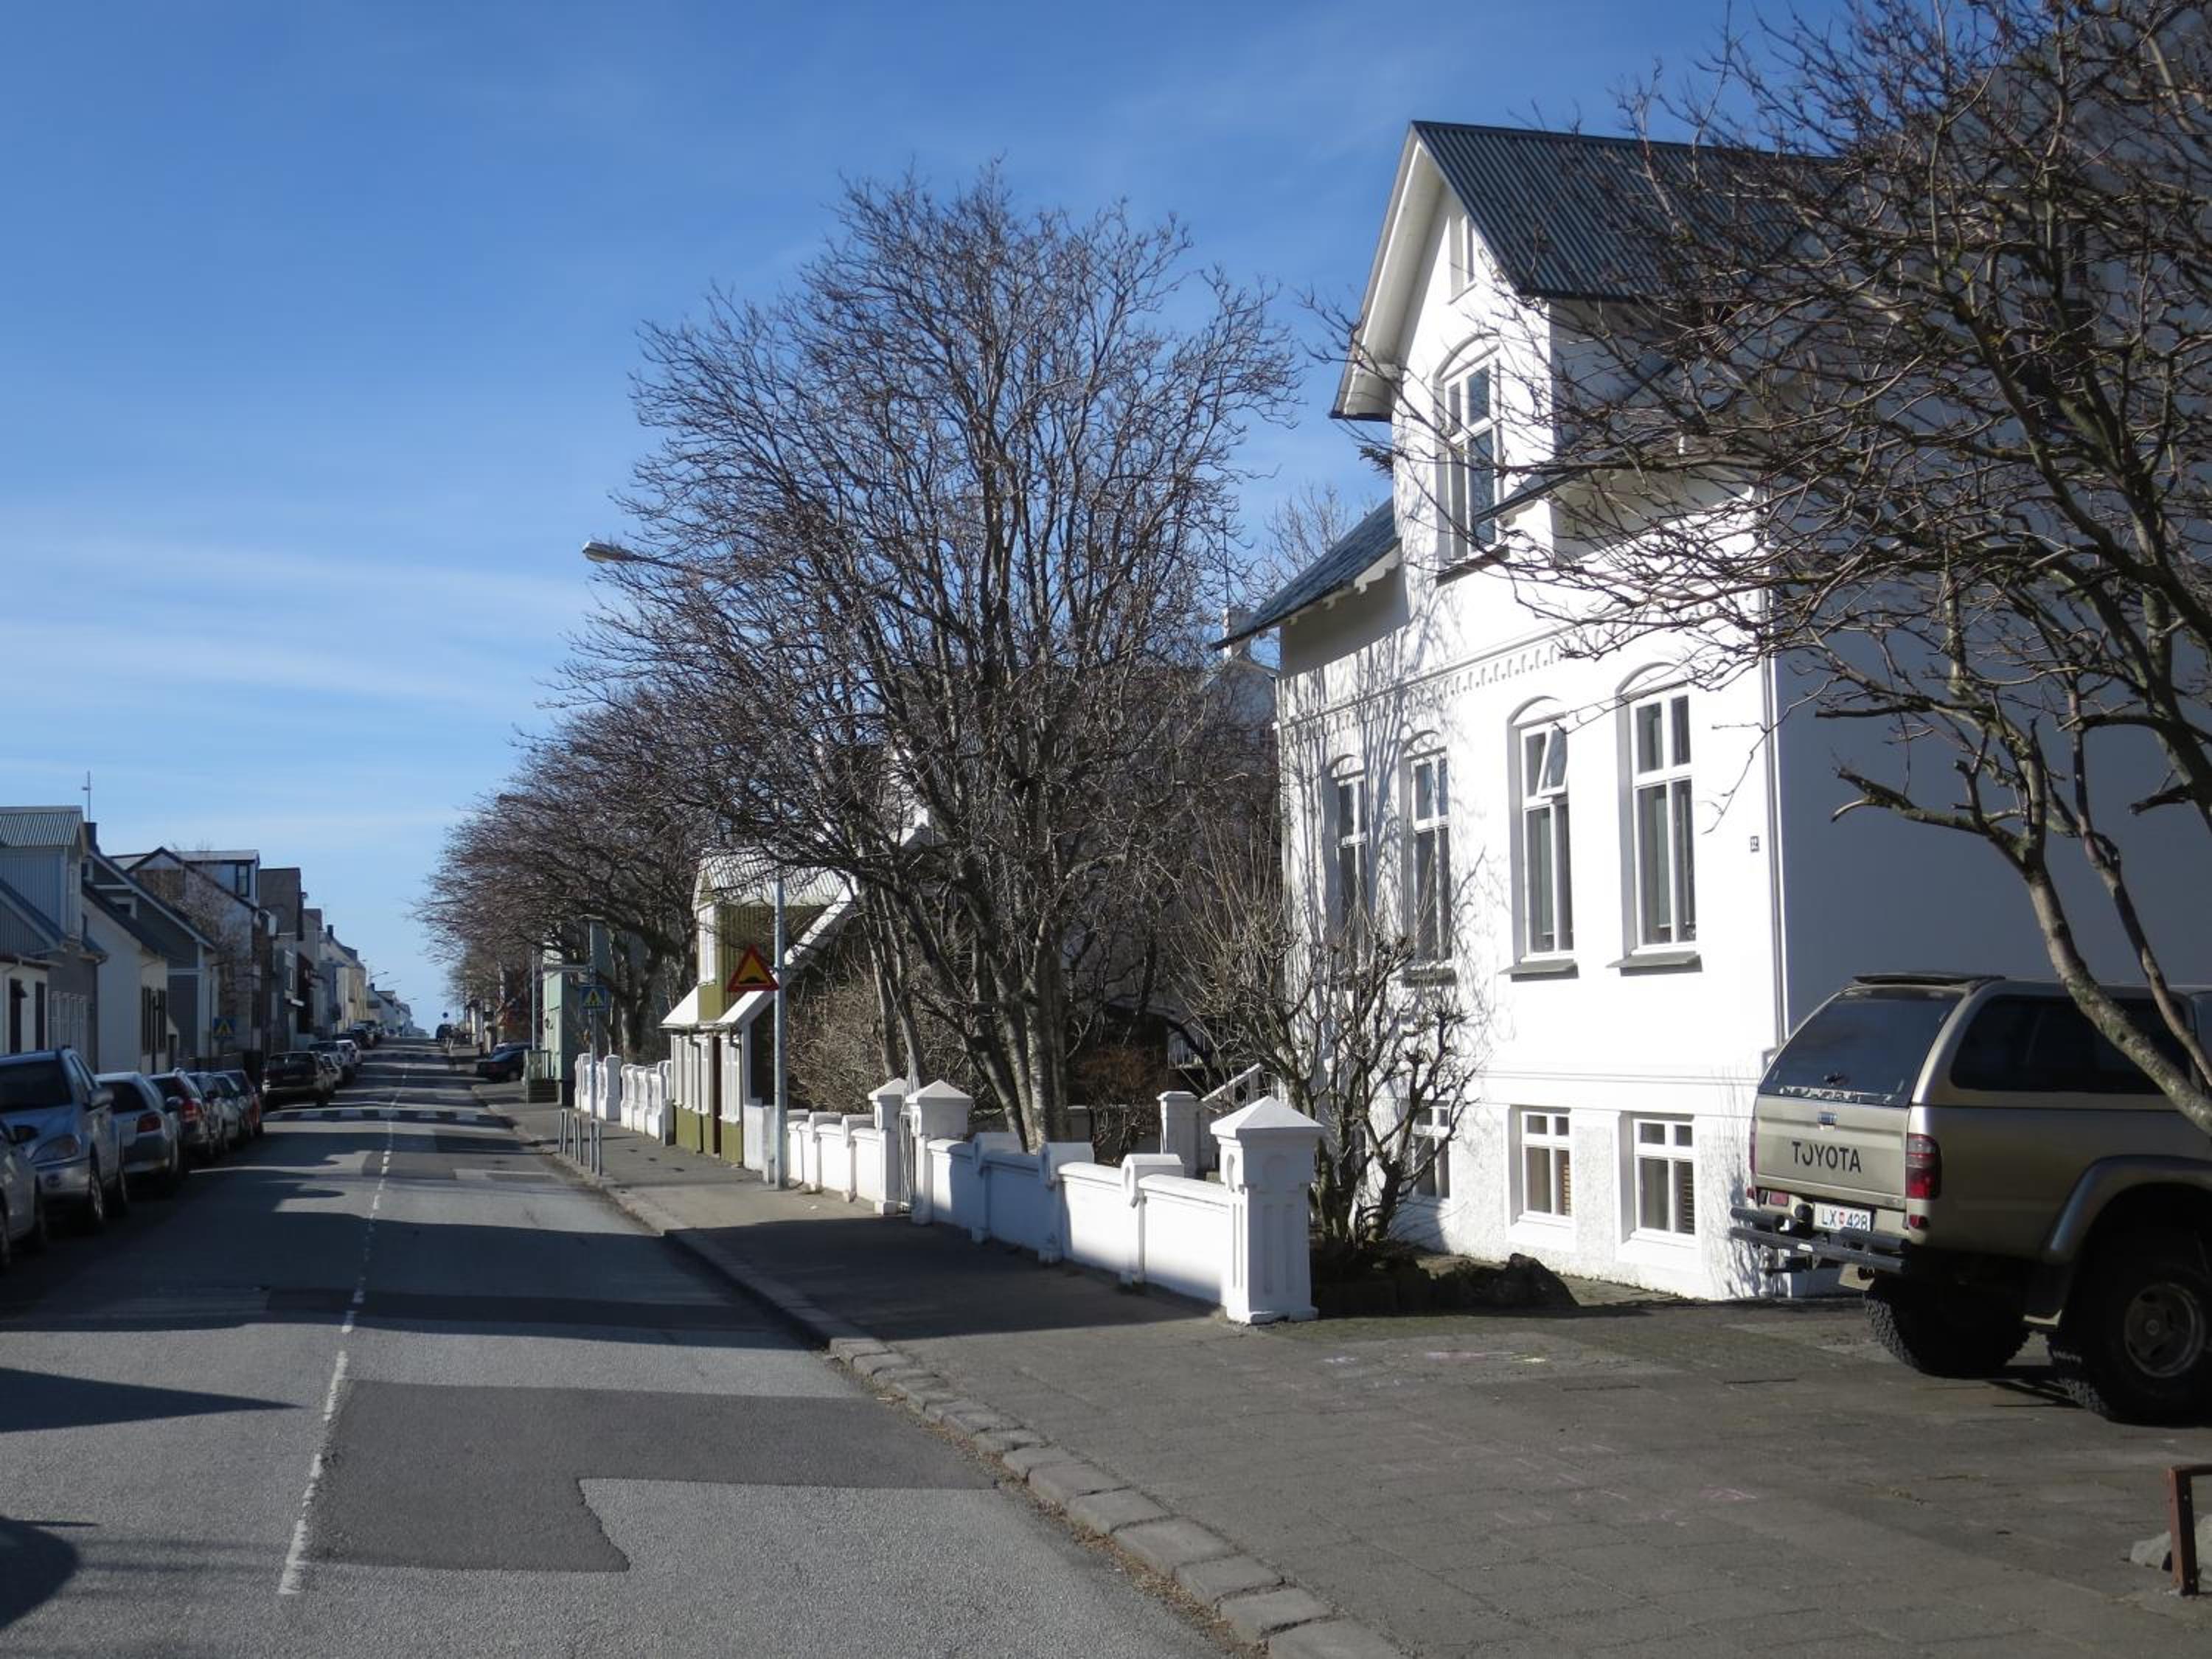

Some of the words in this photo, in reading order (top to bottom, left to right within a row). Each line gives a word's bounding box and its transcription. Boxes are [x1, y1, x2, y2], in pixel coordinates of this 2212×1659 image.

[1792, 1141, 1861, 1173] TOYOTA
[1821, 1209, 1837, 1227] LX
[1846, 1213, 1868, 1230] 428
